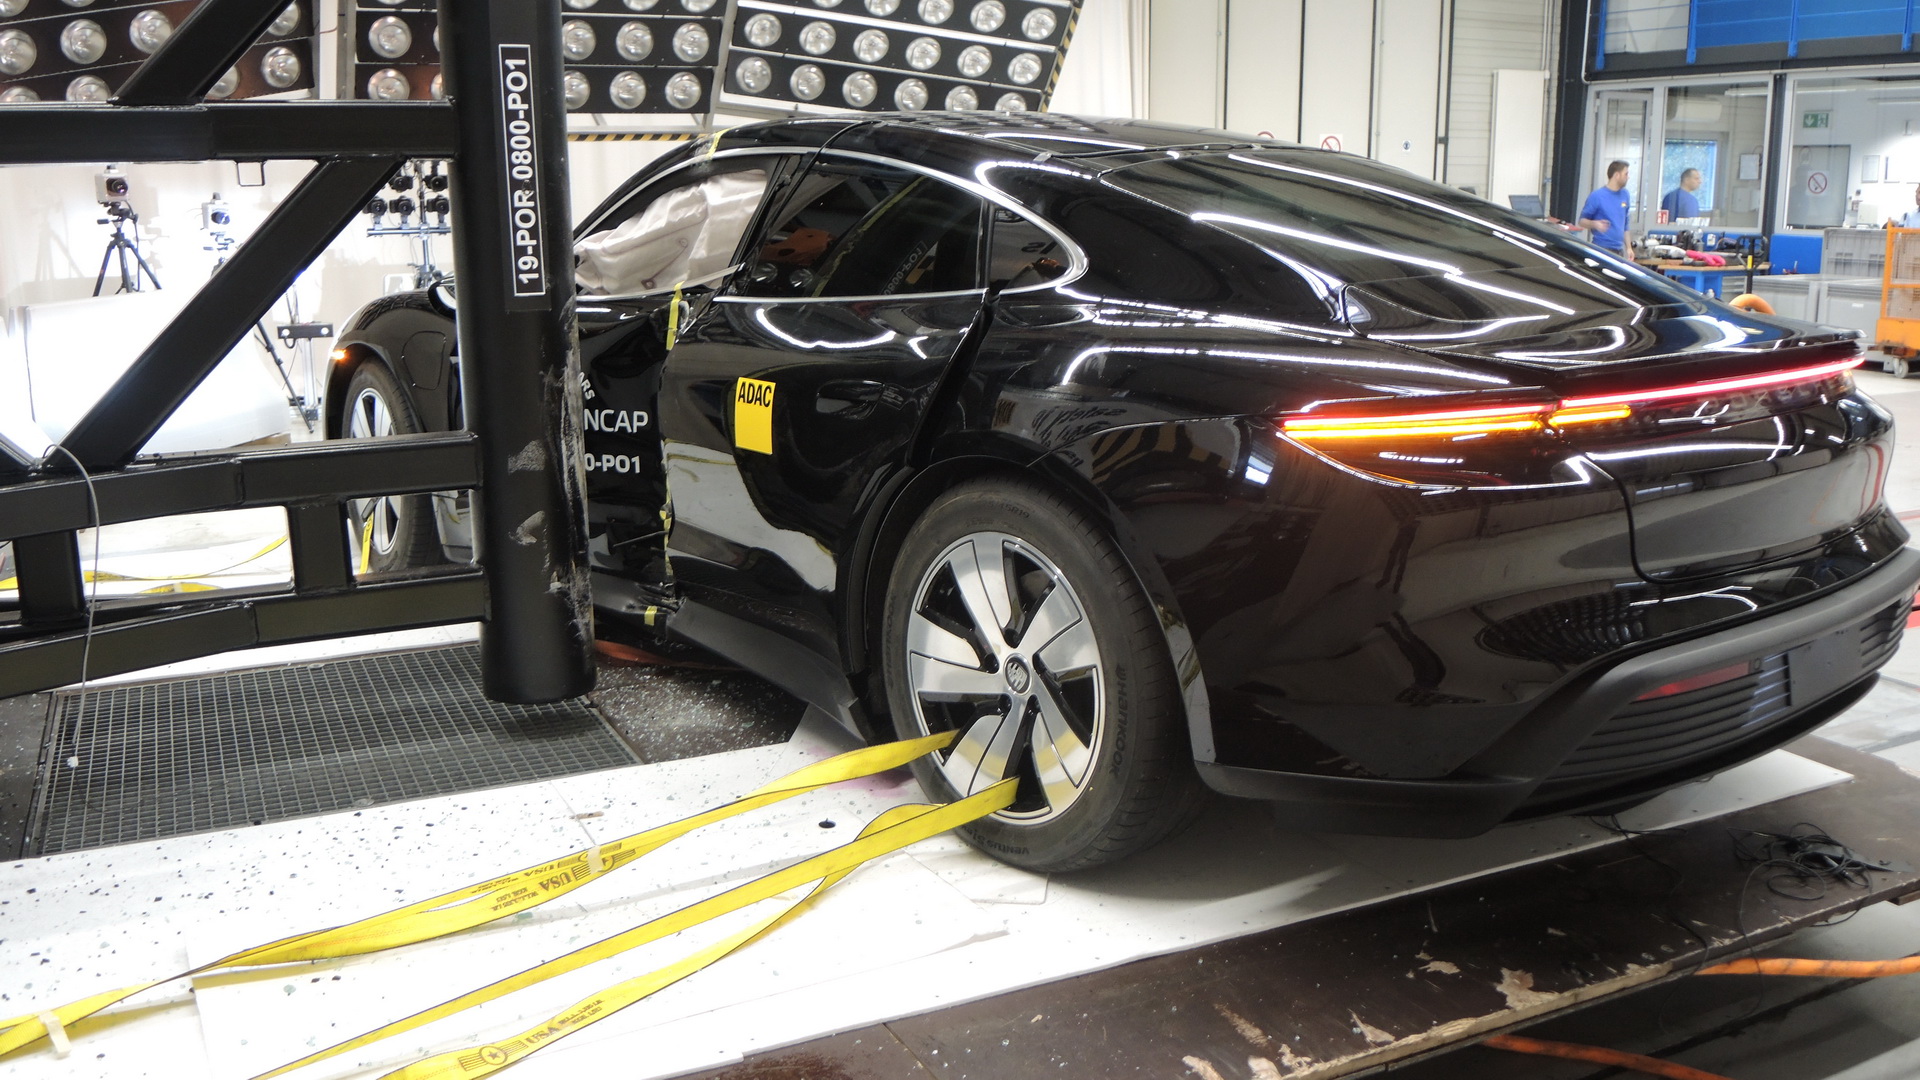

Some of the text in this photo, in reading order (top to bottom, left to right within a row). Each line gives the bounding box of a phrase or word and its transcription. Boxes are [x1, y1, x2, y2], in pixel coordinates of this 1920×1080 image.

[514, 189, 539, 284] 19-POR
[738, 381, 772, 407] ADAC
[584, 408, 649, 433] NCAP
[539, 872, 573, 891] USA
[525, 1025, 560, 1044] USA
